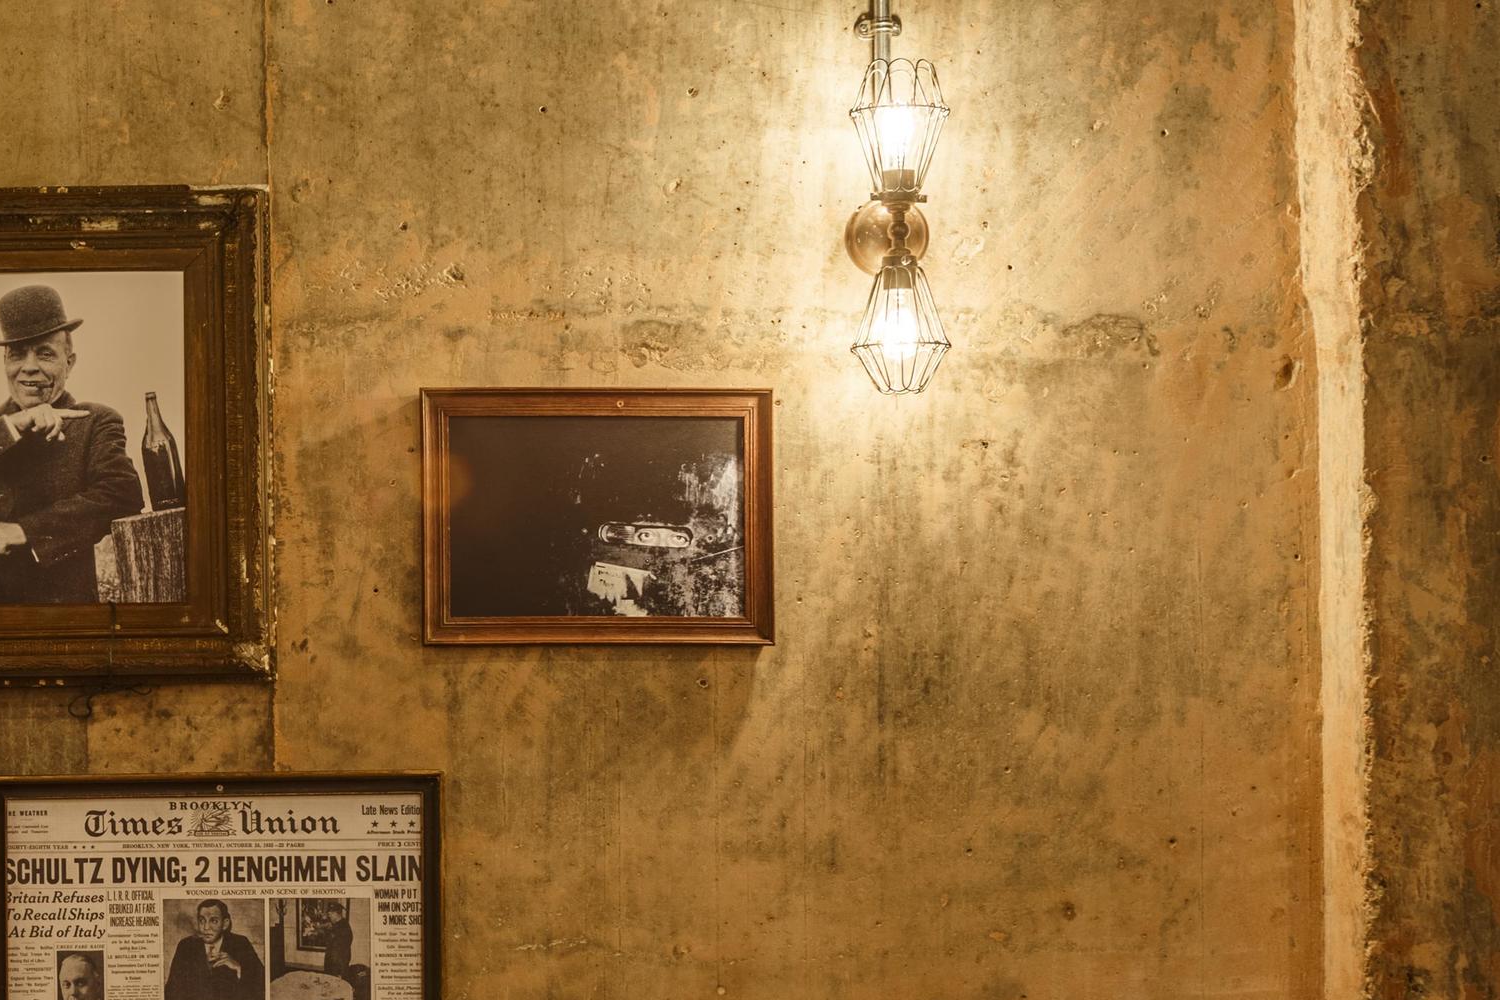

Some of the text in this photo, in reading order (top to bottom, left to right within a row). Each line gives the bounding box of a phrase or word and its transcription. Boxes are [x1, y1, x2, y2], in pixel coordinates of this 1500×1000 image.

[169, 801, 252, 811] BROOKLYN
[362, 804, 377, 815] Late
[380, 804, 398, 815] News
[84, 809, 340, 838] Times Union
[6, 855, 421, 886] SCHULTZ DYING; 2 HENCHMEN SLAIN
[6, 891, 104, 904] Britain Refuses
[132, 890, 155, 900] OFFICIAL
[374, 889, 417, 899] WOMAN PUT
[109, 903, 156, 914] REBUKED AT FARE
[378, 902, 390, 912] HIM
[391, 902, 401, 912] ON
[7, 908, 105, 922] To Recall Ships
[382, 915, 388, 925] 3
[389, 915, 407, 925] MORE
[110, 916, 159, 927] INCREASE HEARING
[8, 925, 106, 939] At Bid of Italy
